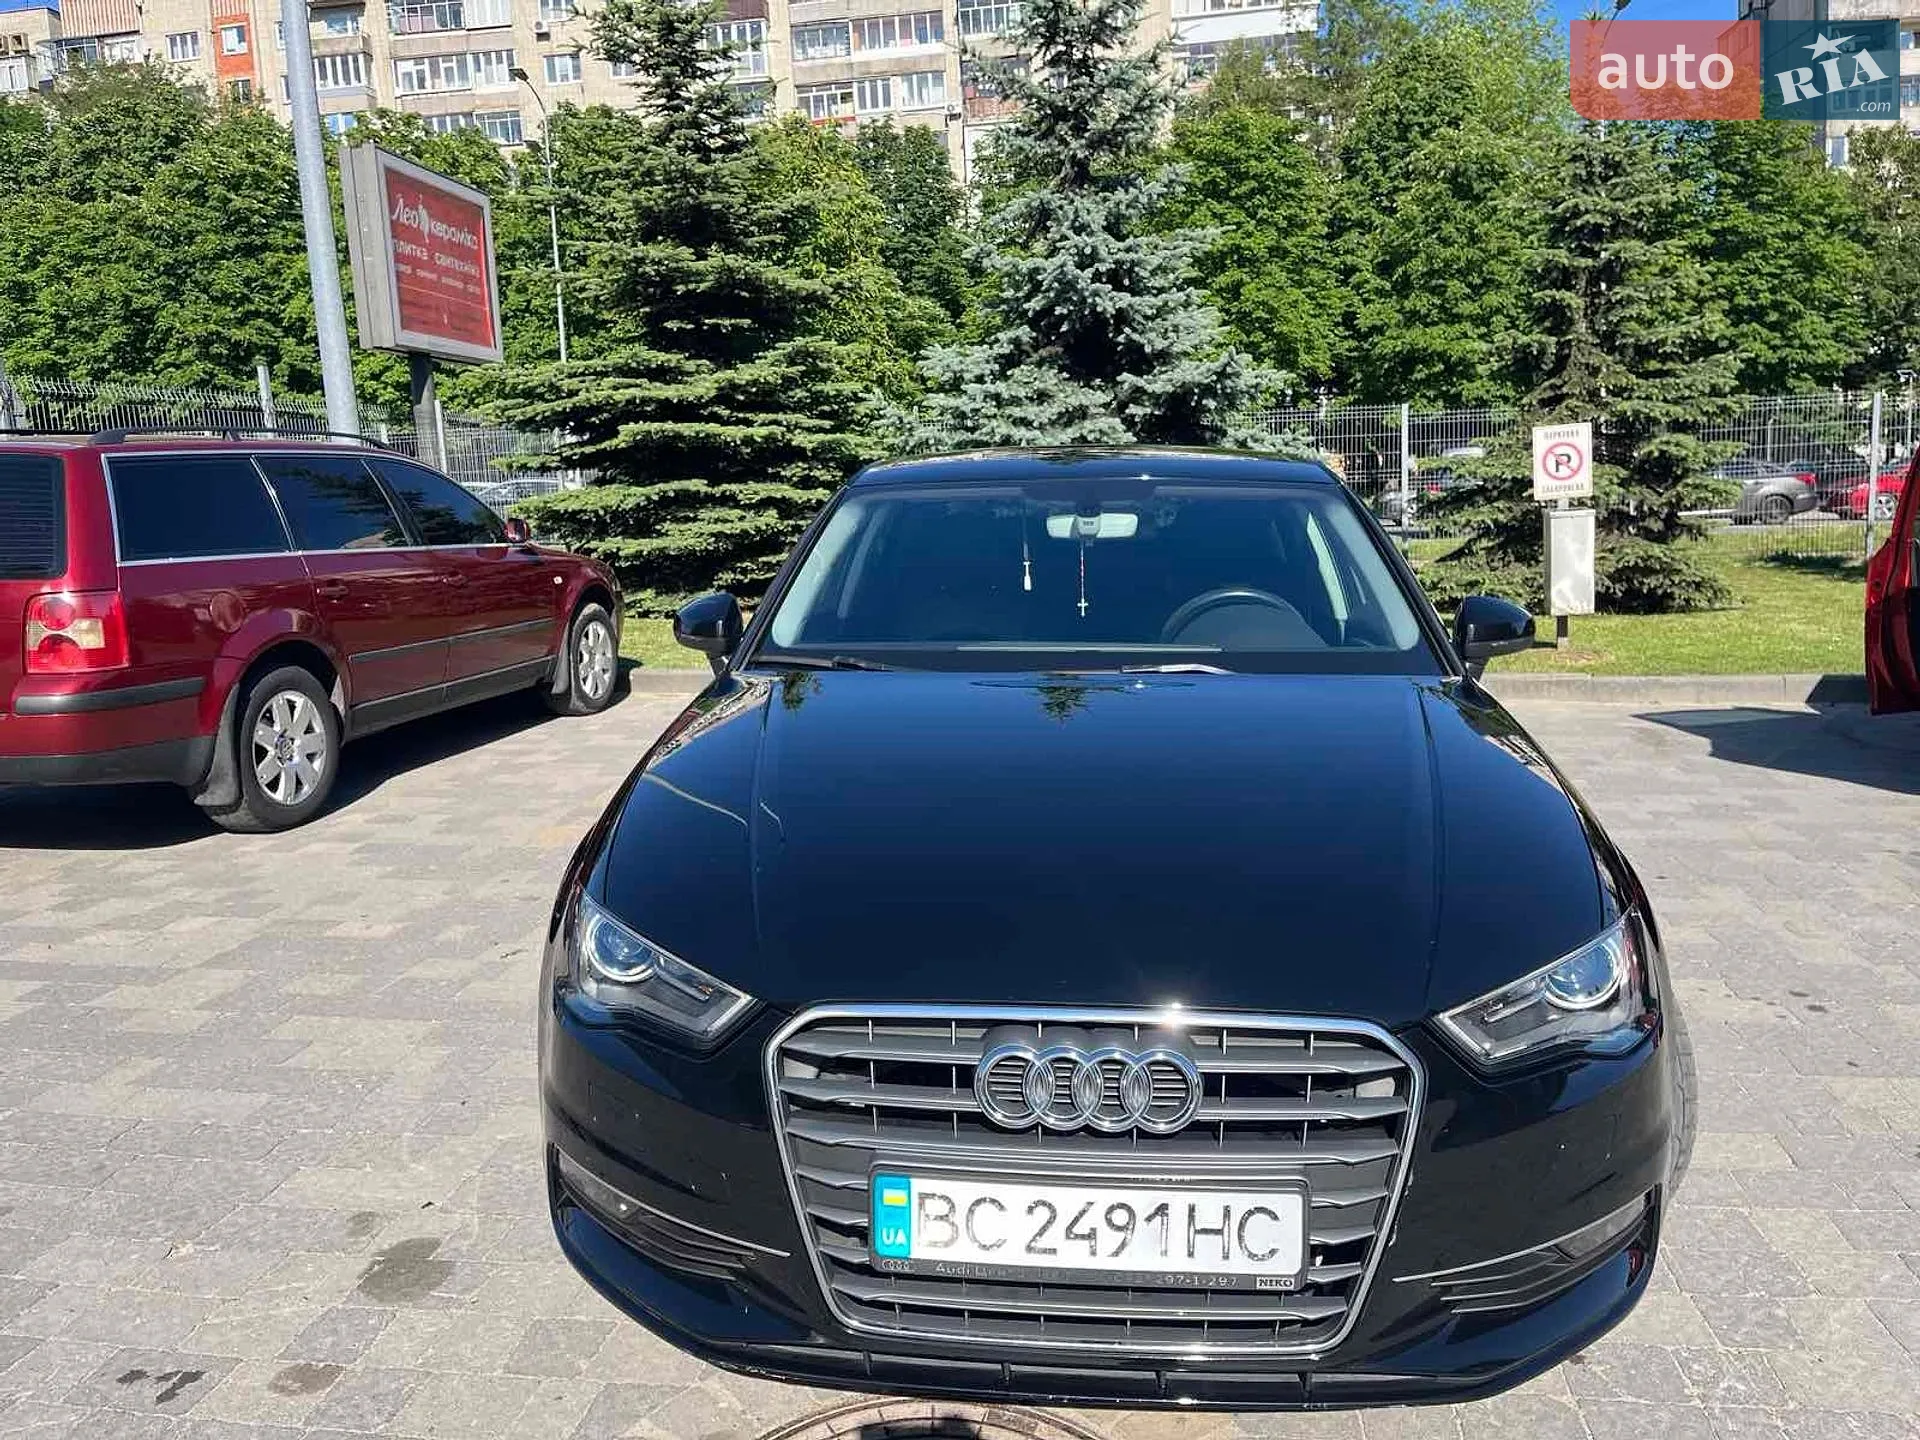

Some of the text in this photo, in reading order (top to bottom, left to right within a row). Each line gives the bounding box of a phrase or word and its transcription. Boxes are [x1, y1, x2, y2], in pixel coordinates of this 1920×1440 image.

[917, 1191, 1280, 1262] BC 2491 HC
[882, 1228, 908, 1246] UA
[936, 1262, 971, 1277] Audi
